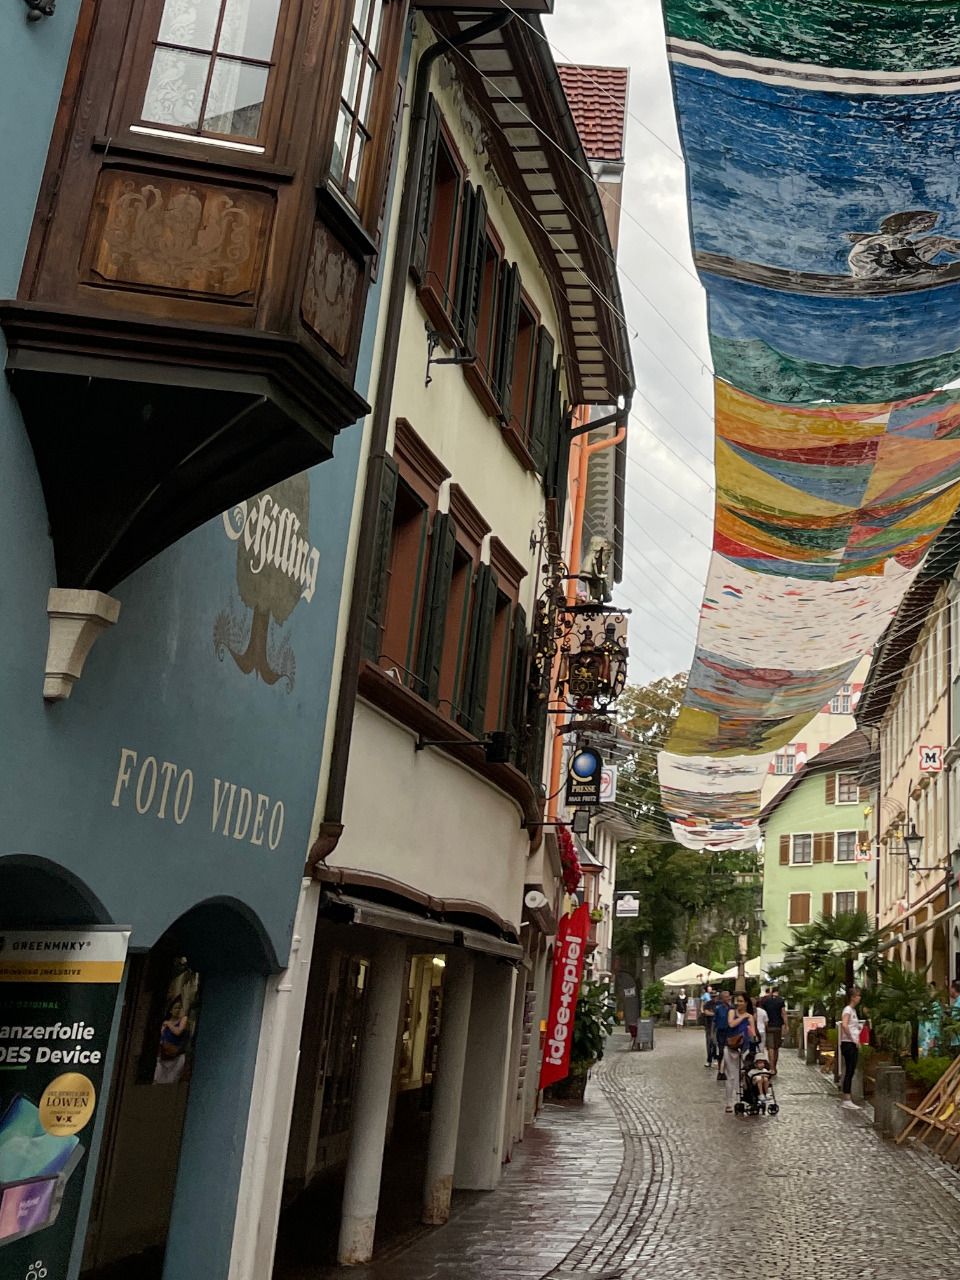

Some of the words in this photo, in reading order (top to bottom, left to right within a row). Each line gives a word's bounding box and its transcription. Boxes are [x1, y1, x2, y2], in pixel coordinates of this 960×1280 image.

[925, 752, 937, 763] M
[571, 785, 597, 793] PRESSE
[112, 748, 194, 825] FOTO
[211, 778, 285, 851] VIDEO
[546, 935, 582, 1066] idee+spiel
[36, 1044, 102, 1064] Device
